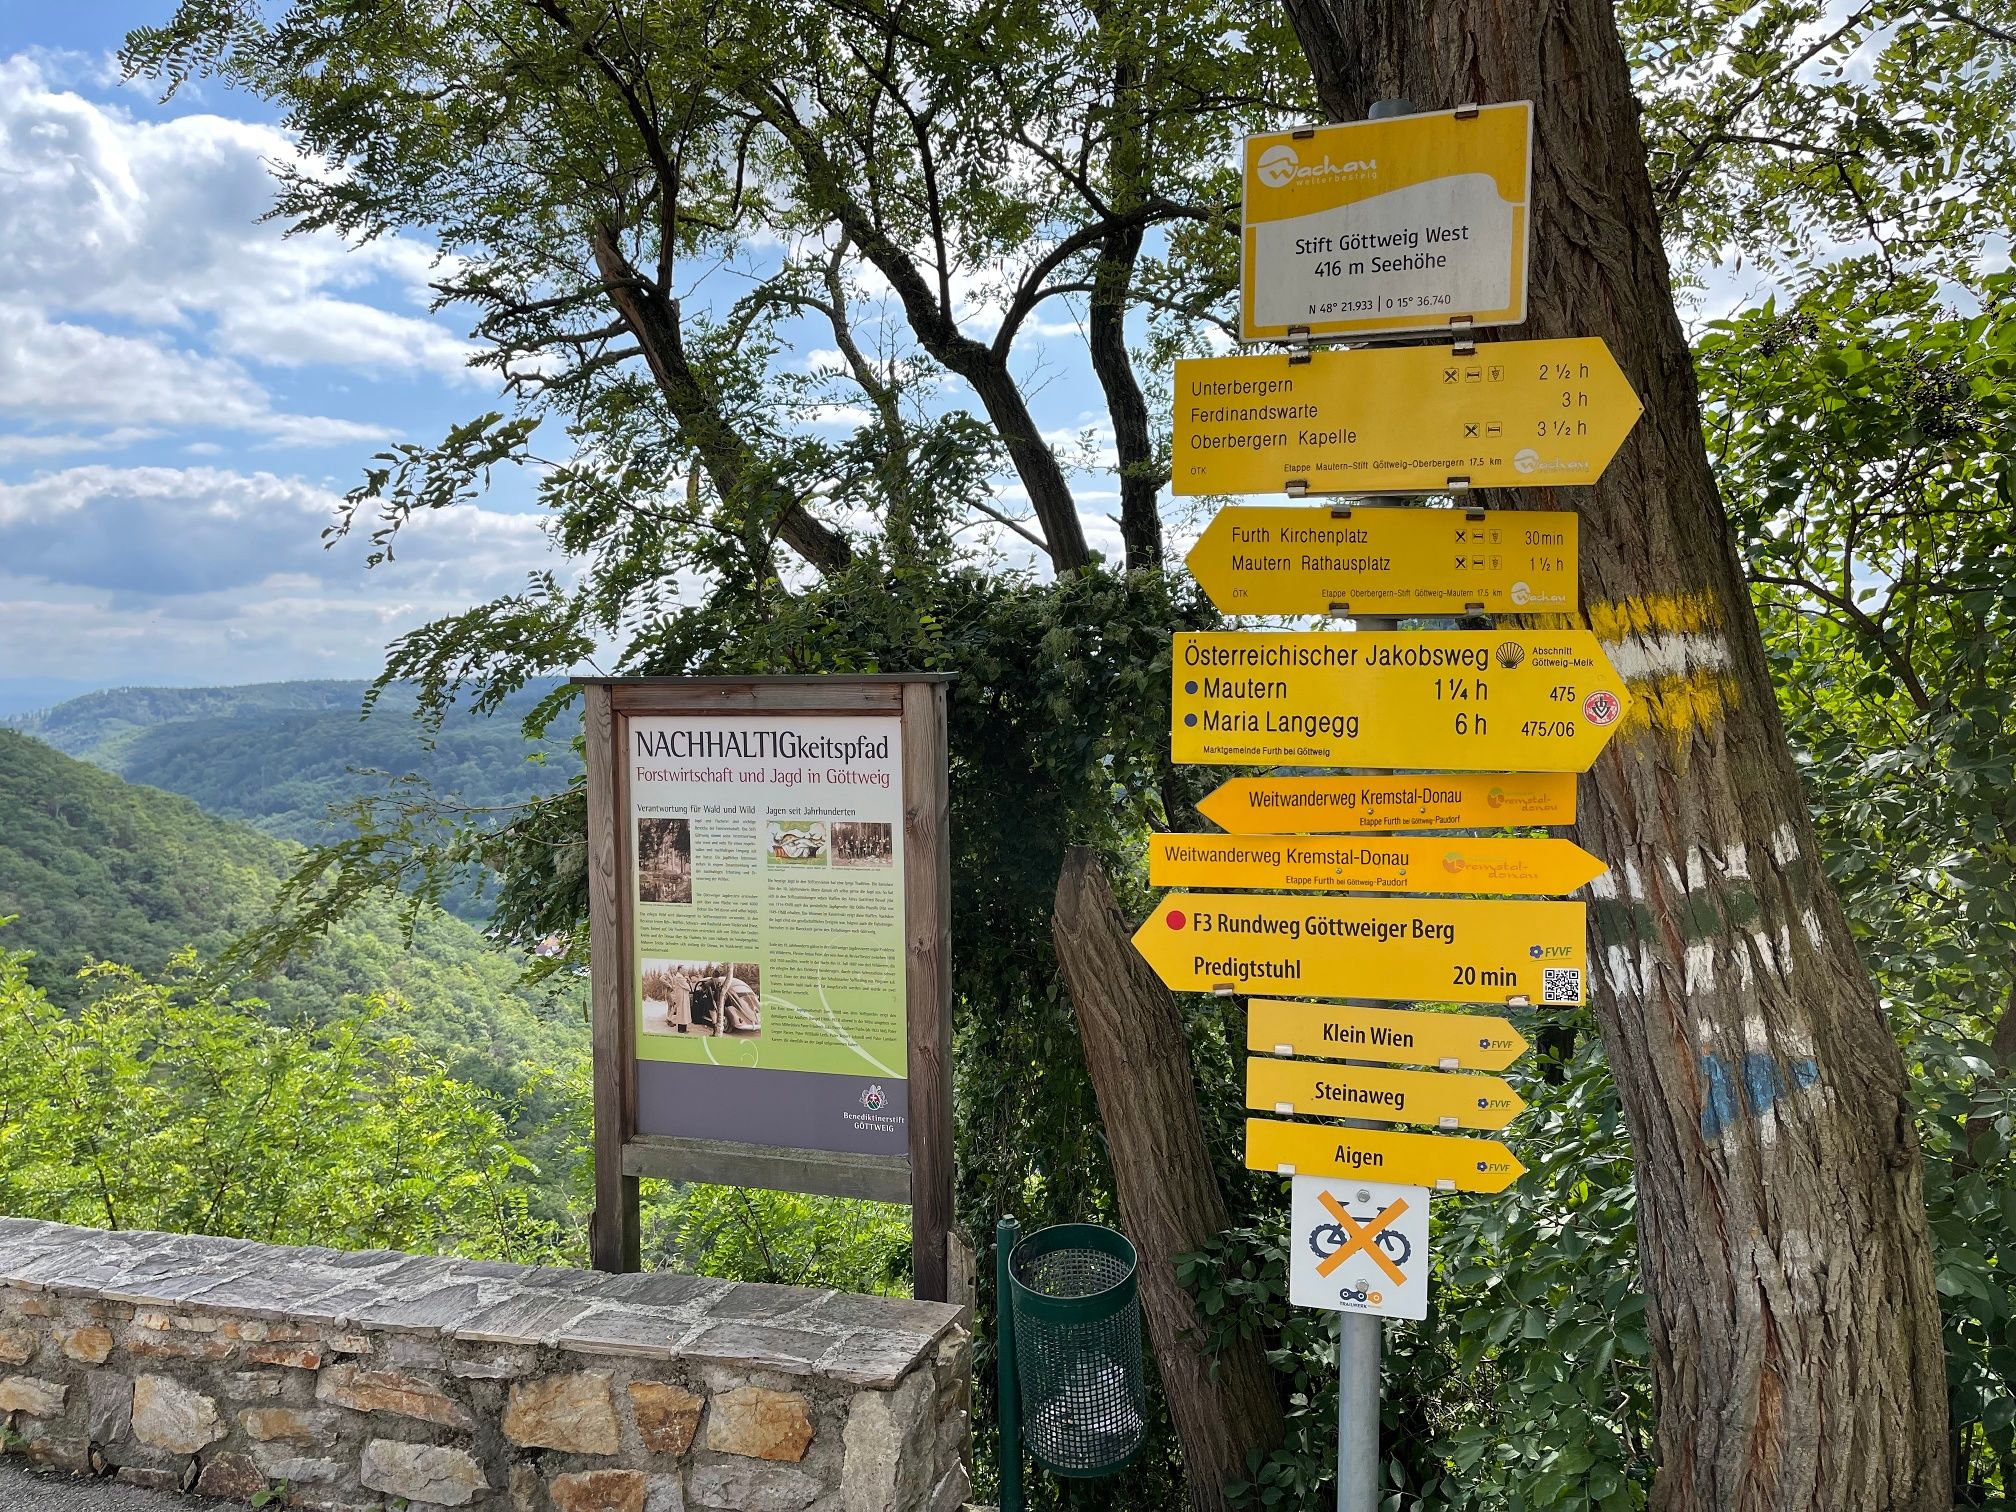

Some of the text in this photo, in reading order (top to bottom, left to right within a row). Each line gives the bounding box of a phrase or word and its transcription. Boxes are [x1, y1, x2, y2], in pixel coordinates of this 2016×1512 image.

[1296, 226, 1468, 254] Stift Göttweig West
[1315, 253, 1446, 277] 416 m Seehöhe
[1309, 304, 1316, 315] N
[1319, 302, 1338, 314] 48°
[1341, 300, 1373, 312] 21.933
[1397, 296, 1414, 308] 15°
[1417, 294, 1451, 307] 36.740
[1192, 380, 1292, 396] Unterbergern
[1540, 365, 1548, 380] 2
[1580, 363, 1588, 378] h
[1192, 392, 1587, 422] Ferdinandswarte 3 h
[1191, 434, 1286, 450] Oberbergern
[1299, 429, 1356, 447] Kapelle
[1538, 421, 1546, 436] 3
[1578, 420, 1586, 435] h
[1284, 463, 1311, 473] Etappe
[1315, 461, 1369, 471] Mautern-Stift
[1489, 457, 1502, 466] km
[1233, 527, 1563, 546] Furth Kirchenplatz 30min
[1233, 555, 1290, 570] Mautern
[1302, 555, 1390, 574] Rathausplatz
[1529, 557, 1535, 571] 1
[1556, 557, 1564, 572] h
[1232, 587, 1249, 598] ÖTK
[1321, 588, 1347, 599] Etappe
[1349, 588, 1411, 599] Oberbergern-Stift
[1414, 588, 1474, 599] Göttweig-Mautern
[1492, 588, 1503, 597] km
[1185, 639, 1488, 671] Österreichischer Jakobsweg
[1532, 646, 1572, 656] Abschnitt
[1531, 657, 1594, 669] Göttweig-Melk
[1205, 678, 1286, 698] Mautern
[1435, 679, 1441, 700] 1
[1476, 679, 1487, 700] h
[1550, 687, 1575, 702] 475
[1204, 711, 1574, 738] Maria Langegg 6 h 475/06
[635, 731, 888, 764] NACHHALTIGkeitspfad
[1203, 745, 1331, 758] Marktgemeinde Furth bei Göttweig
[637, 767, 889, 788] Forstwirtschaft und Jagd in Göttweig
[1249, 788, 1461, 808] Weitwanderweg Kremstal-Donau
[636, 803, 756, 815] Verantwortung für Wald und Wild
[766, 806, 856, 817] Jagen seit Jahrhunderten
[1359, 817, 1383, 828] Etappe
[1383, 816, 1402, 826] Furth
[1410, 814, 1461, 826] Göttweig-Paudorf
[1165, 847, 1408, 866] Weitwanderweg Kremstal-Donau
[1285, 875, 1408, 887] Etappe Furth bei Göttweig-Paudorf
[1194, 913, 1454, 944] F3 Rundweg Göttweiger Berg
[1545, 946, 1573, 958] FVVF
[1195, 957, 1516, 986] Predigtstuhl 20 min
[1324, 1023, 1413, 1047] Klein Wien
[1491, 1040, 1513, 1049] FVVF
[1316, 1082, 1404, 1110] Steinaweg
[1489, 1099, 1512, 1109] FVVF
[843, 1112, 905, 1124] Benediktinerstift
[854, 1120, 895, 1133] GÖTTWEIG
[1335, 1145, 1383, 1168] Aigen
[1488, 1163, 1511, 1172] FVVF
